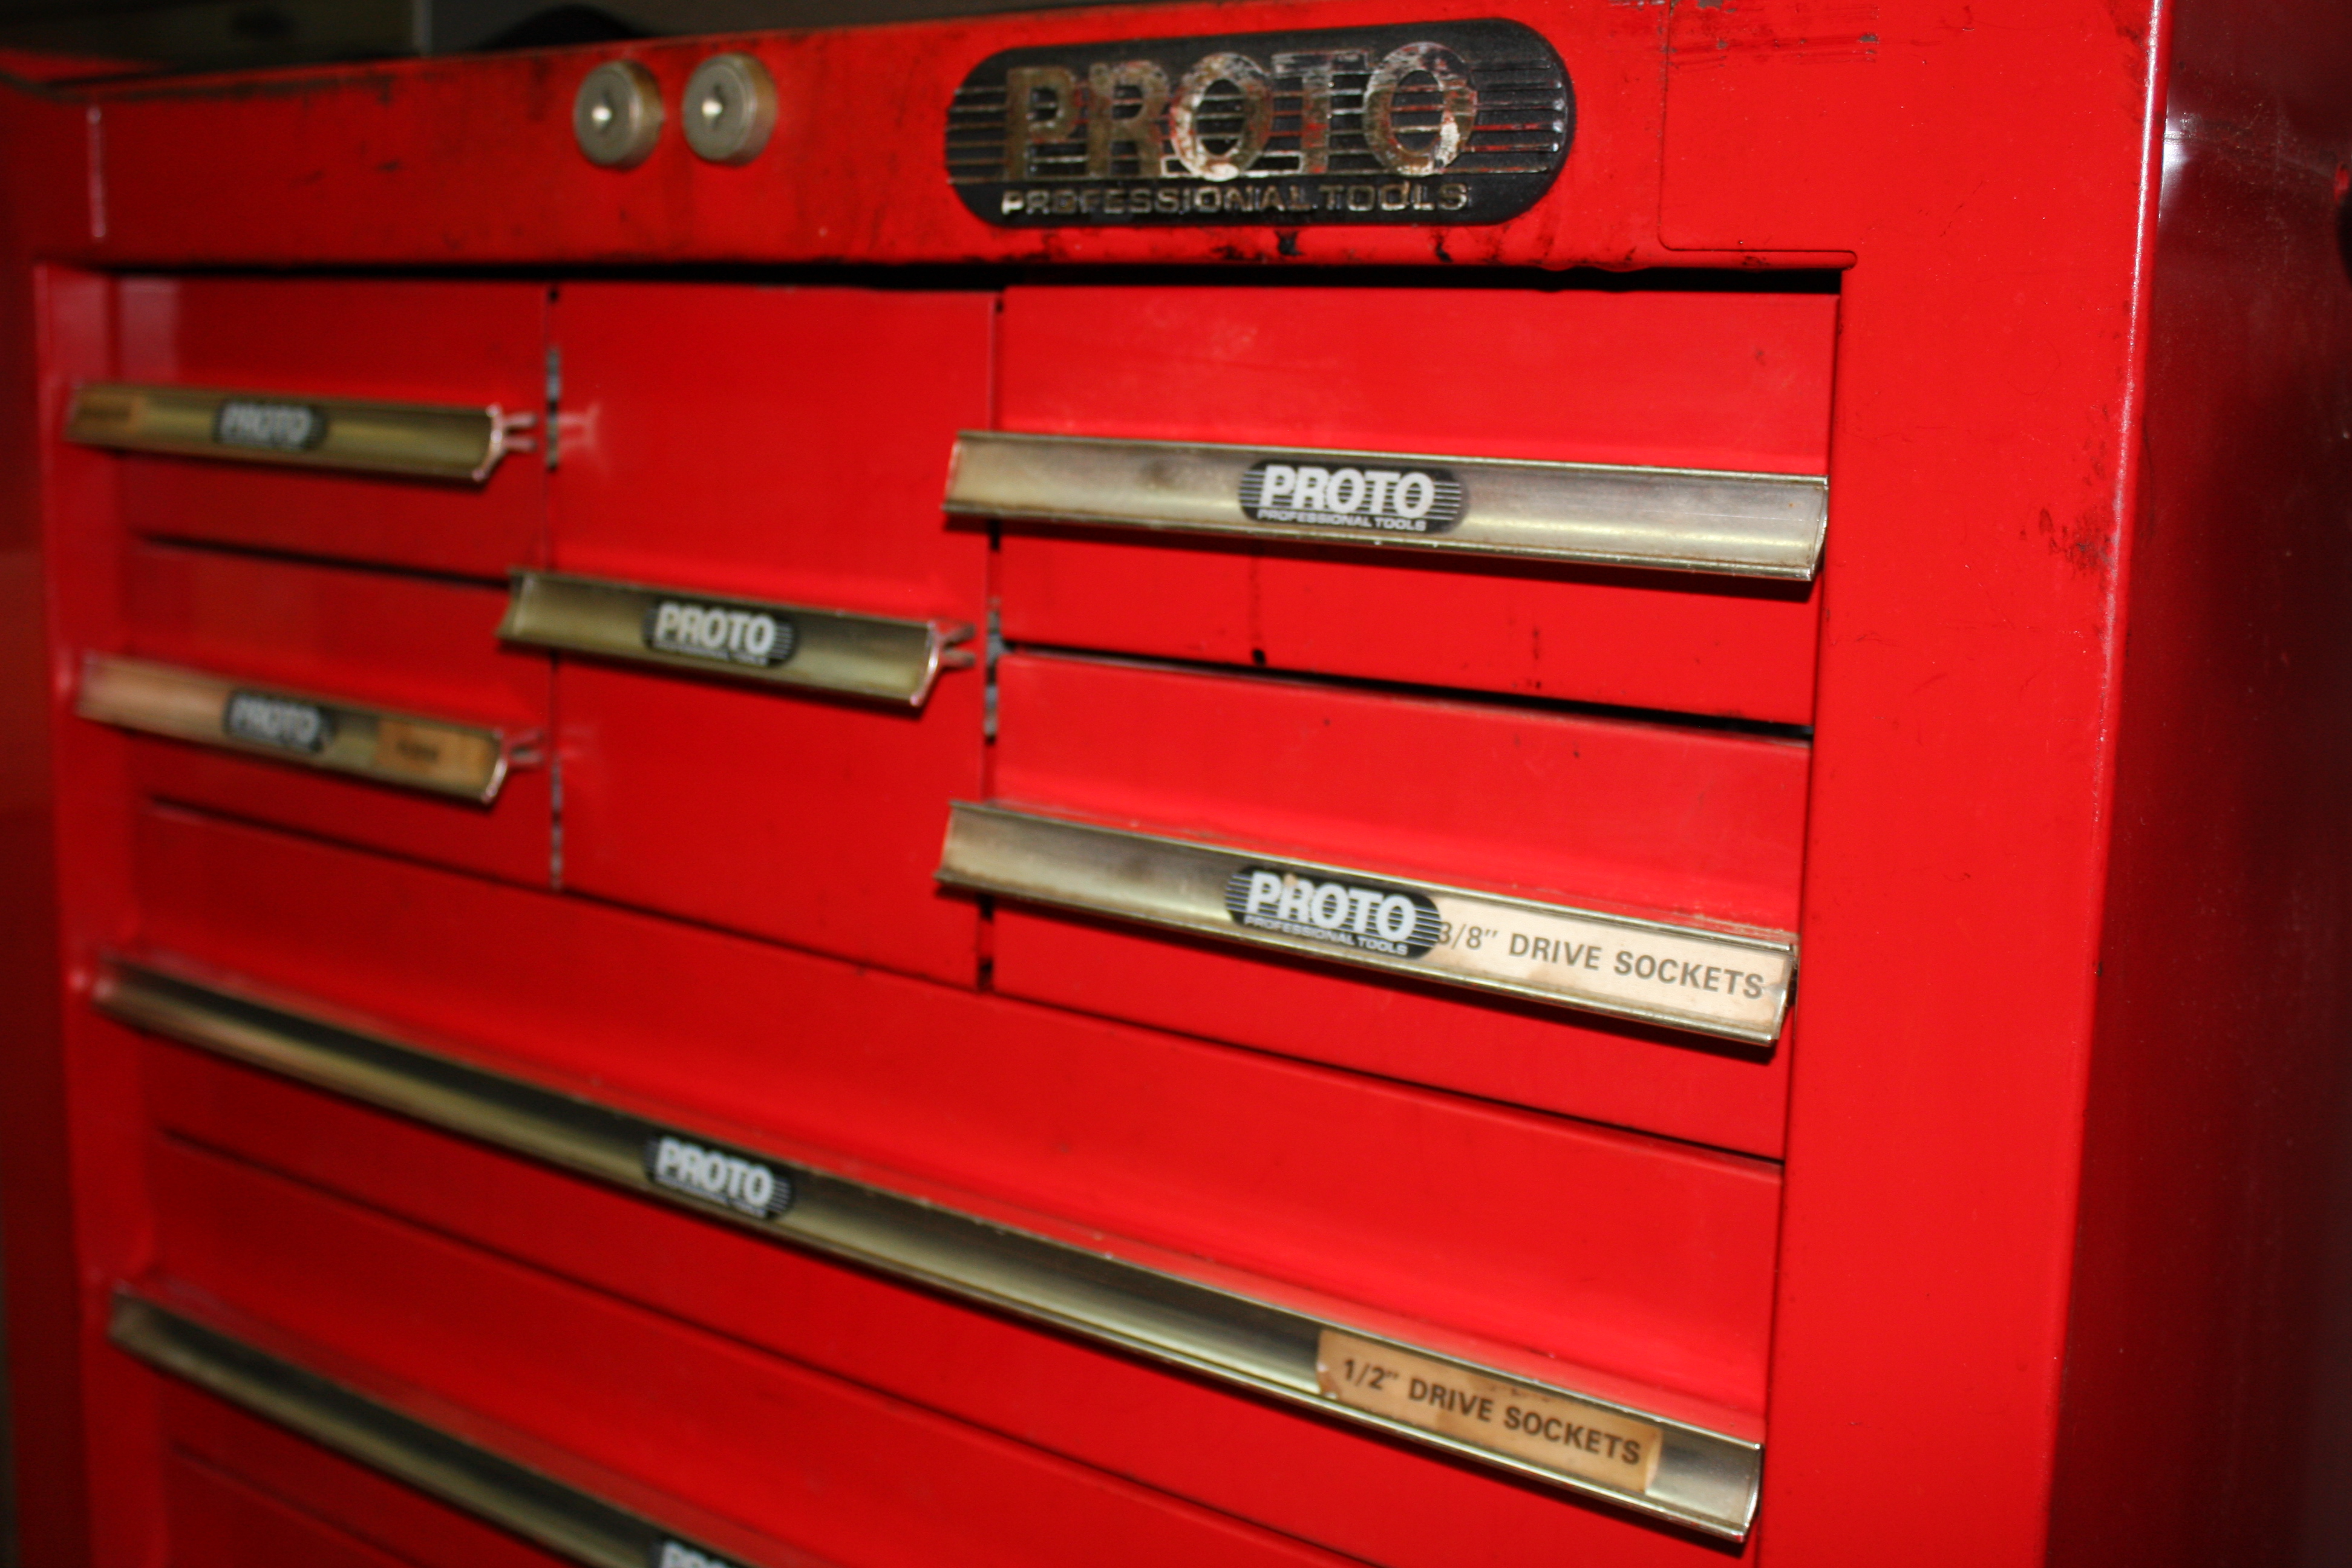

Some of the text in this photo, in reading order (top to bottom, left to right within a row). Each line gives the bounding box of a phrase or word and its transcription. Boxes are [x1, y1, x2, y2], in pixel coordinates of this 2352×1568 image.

[1004, 41, 1478, 181] PROTO
[1001, 181, 1469, 215] PROFESSIONAL TOOLS
[1257, 509, 1426, 532] PROFESSIONAL TOOLS
[1259, 464, 1435, 518] PROTO
[655, 601, 776, 655] PROTO
[1244, 915, 1409, 956] PROFESSIONAL TOOLS
[1246, 871, 1417, 942] PROTO
[1510, 933, 1602, 970] DRIVE
[1614, 951, 1765, 1000] SOCKETS
[656, 1135, 774, 1207] PROTO
[1343, 1359, 1641, 1466] 1/2" DRIVE SOCKETS
